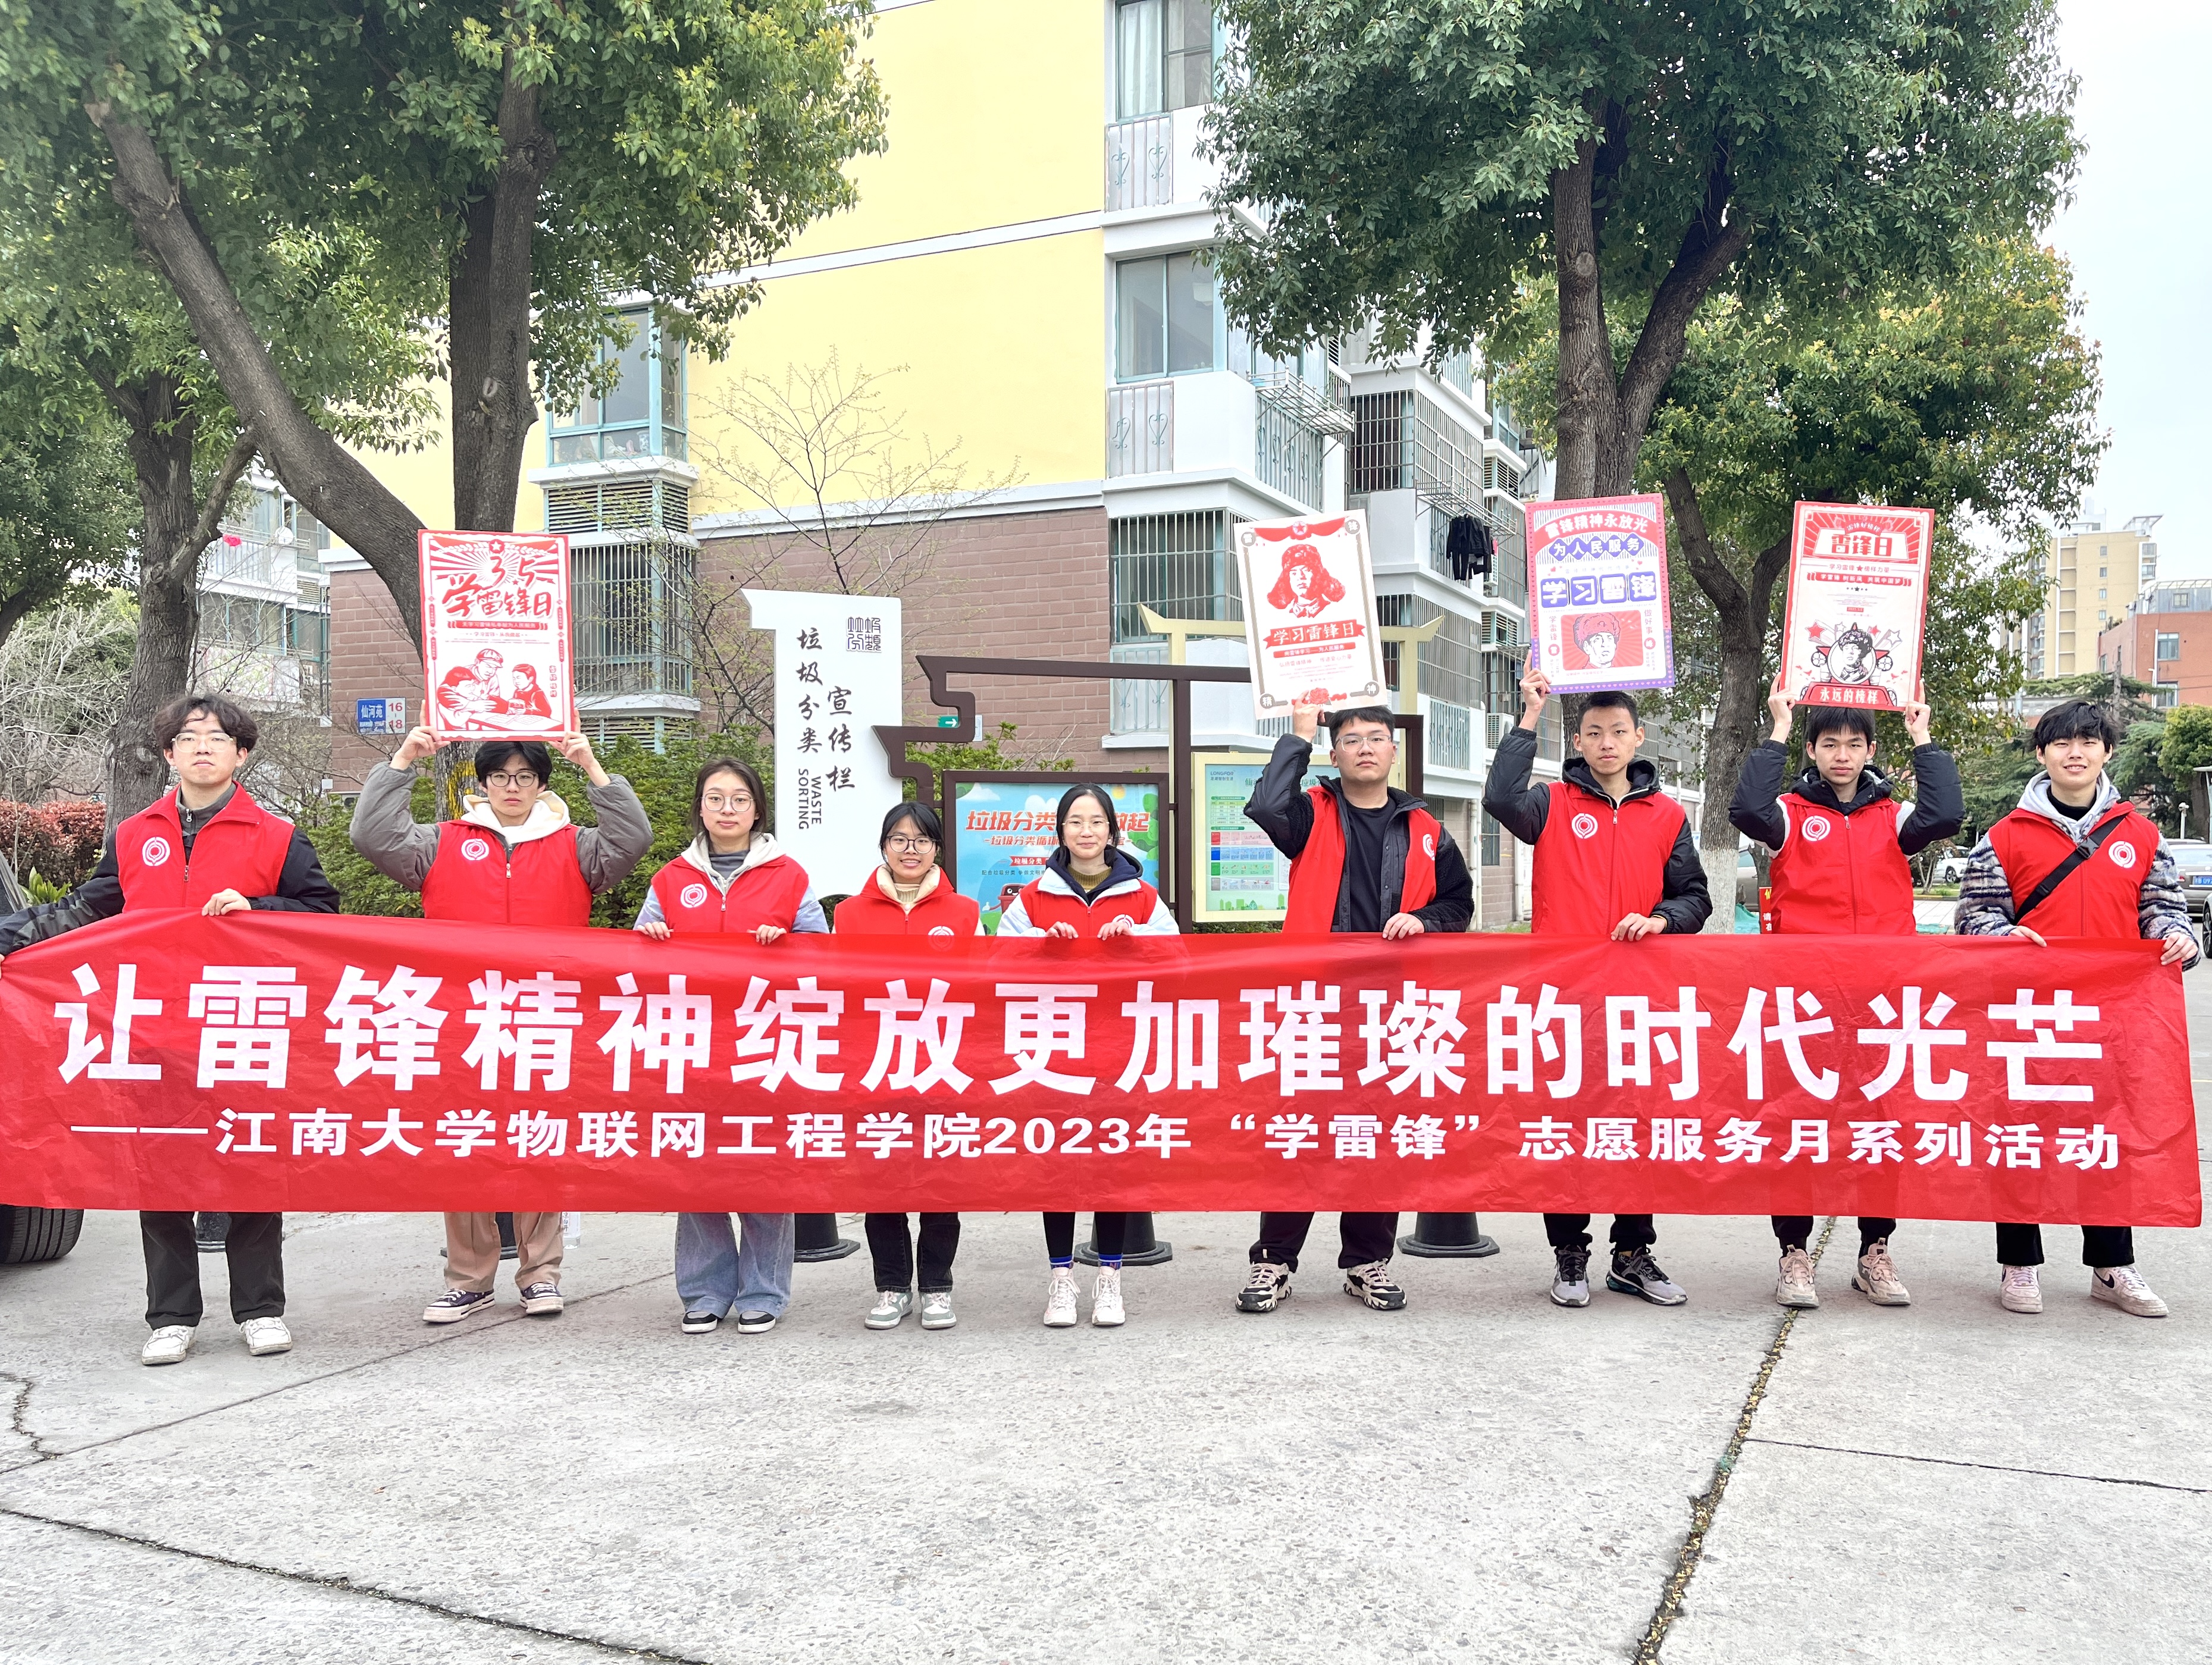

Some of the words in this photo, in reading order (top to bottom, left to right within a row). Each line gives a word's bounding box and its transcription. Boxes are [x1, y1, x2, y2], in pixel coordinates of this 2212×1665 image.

[1544, 513, 1649, 538] 雷锋精神永放光
[1553, 537, 1640, 557] 为人民服务
[1832, 534, 1893, 556] 雷锋日
[442, 573, 552, 617] 学雷锋日
[1543, 574, 1656, 604] 学习雷锋
[1273, 622, 1355, 646] 学习雷锋日
[795, 627, 823, 753] 垃圾分类
[1819, 686, 1879, 705] 永远的榜样
[361, 704, 383, 719] 仙河苑
[388, 703, 403, 711] 16
[388, 720, 403, 729] 18
[825, 686, 855, 792] 宣传栏
[798, 768, 809, 830] SORTING
[811, 776, 822, 824] WASTE
[965, 810, 1057, 832] 垃圾分类
[54, 962, 2103, 1102] 让雷锋精神绽放更加璀璨的时代光芒
[1518, 1115, 2119, 1170] 志愿服务月系列活动
